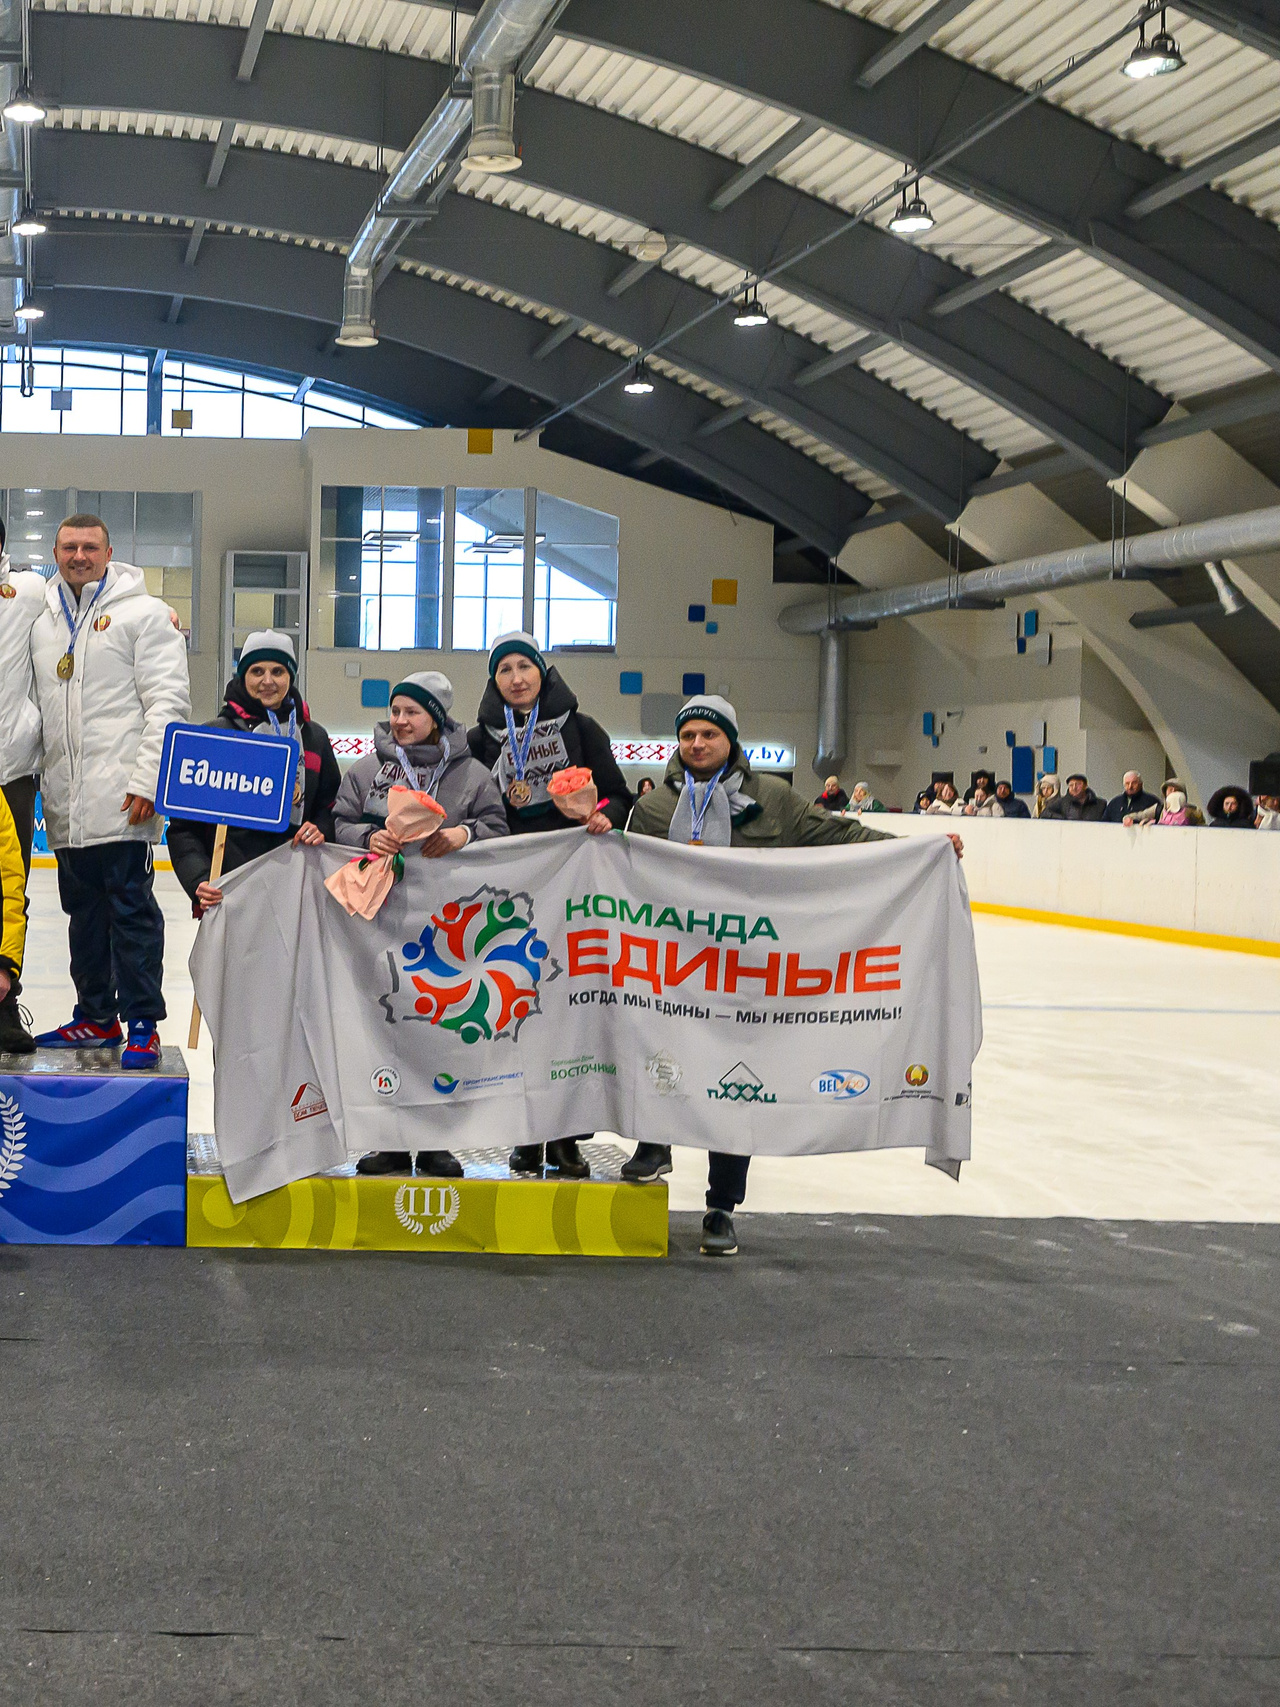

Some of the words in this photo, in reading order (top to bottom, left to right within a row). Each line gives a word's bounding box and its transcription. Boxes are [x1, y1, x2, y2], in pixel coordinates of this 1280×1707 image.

[507, 740, 561, 766] ЕИНЫЕ
[179, 758, 274, 797] Единые
[565, 894, 780, 944] КОМАНДА
[566, 929, 902, 997] ЕДИНЫЕ
[569, 990, 618, 1006] КОГДА
[623, 993, 651, 1009] МЫ
[655, 999, 710, 1019] ЕДИНЫ
[735, 1010, 767, 1024] МЫ
[772, 1006, 902, 1025] НЕПОБЕДИМЫ!
[550, 1062, 617, 1080] ВОСТОЧНЫЙ
[405, 1186, 451, 1217] III
